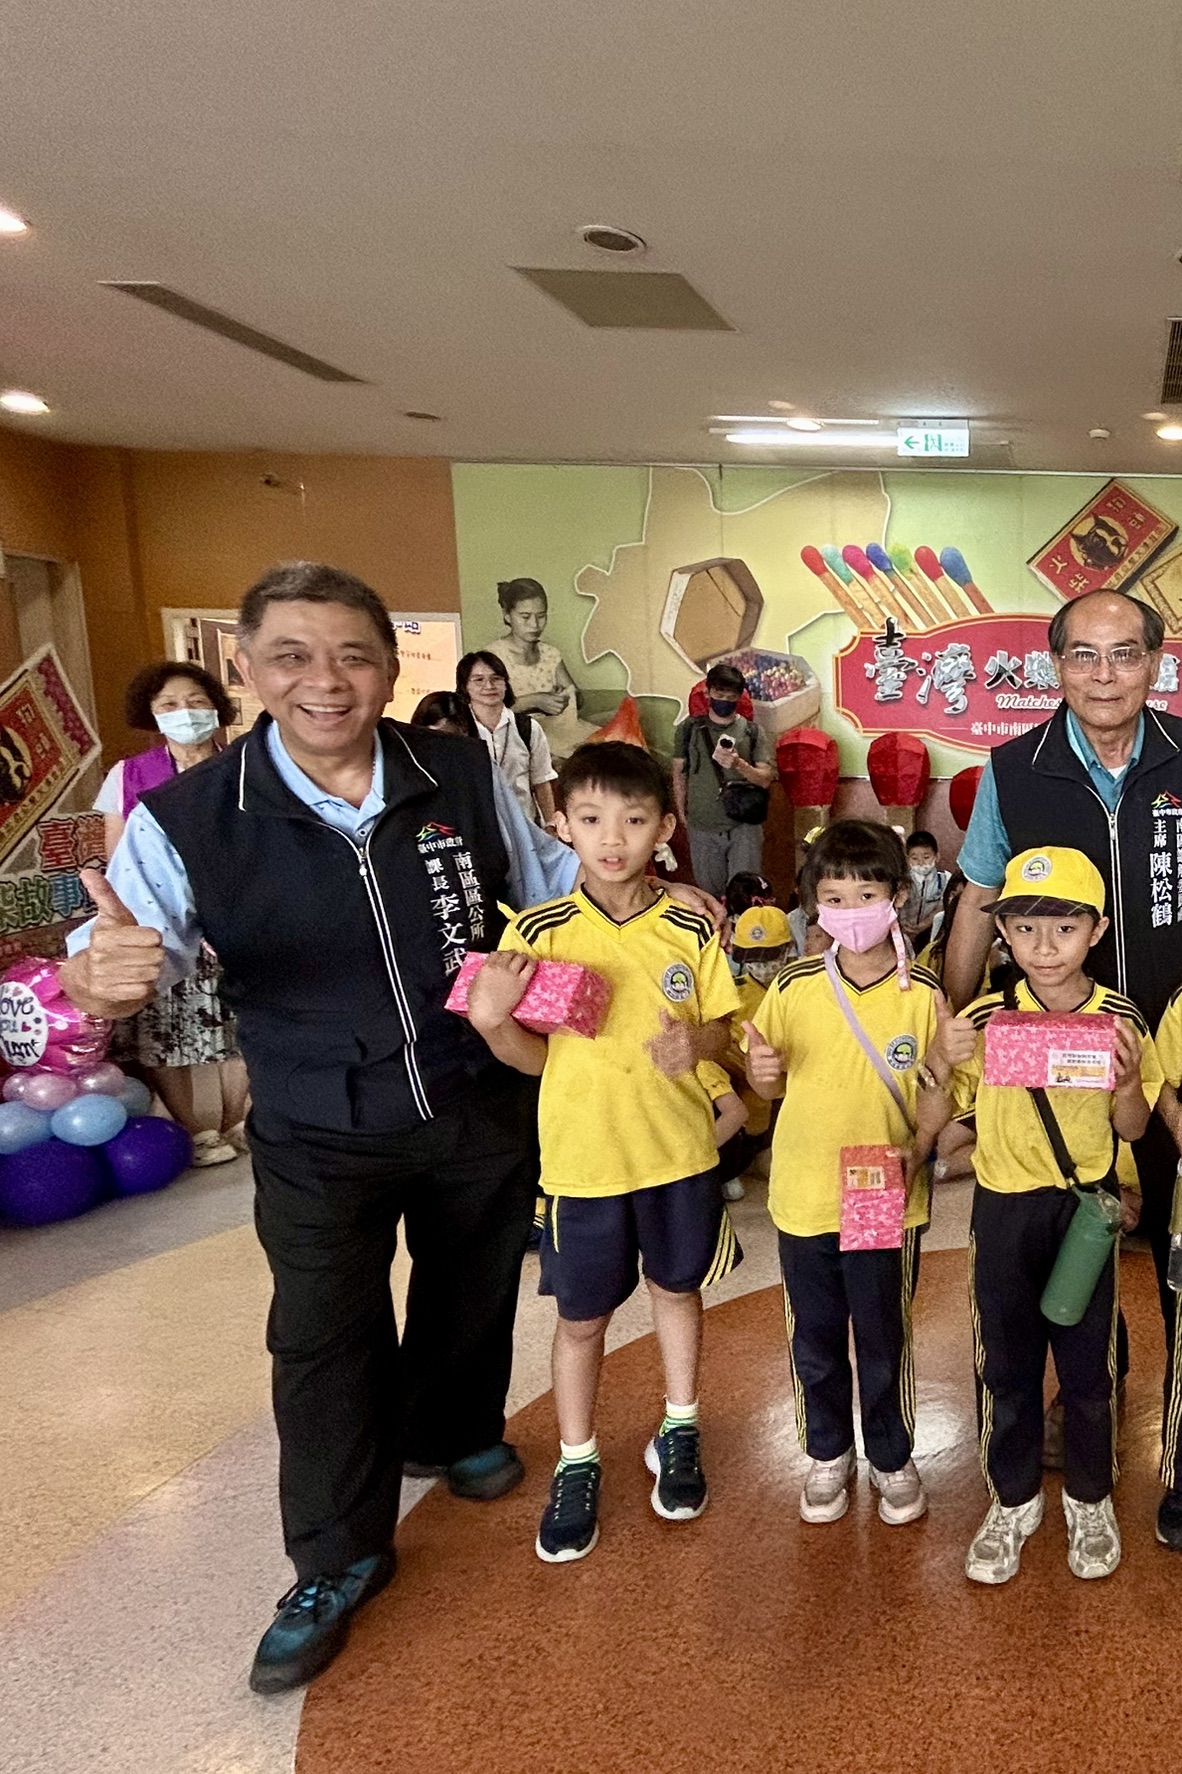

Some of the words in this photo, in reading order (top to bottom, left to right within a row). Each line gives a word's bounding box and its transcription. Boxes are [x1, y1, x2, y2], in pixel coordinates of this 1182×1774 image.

[1153, 819, 1167, 848] 主席
[424, 856, 451, 892] 課長
[453, 851, 486, 942] 南區區公所
[1150, 851, 1173, 928] 陳松鶴
